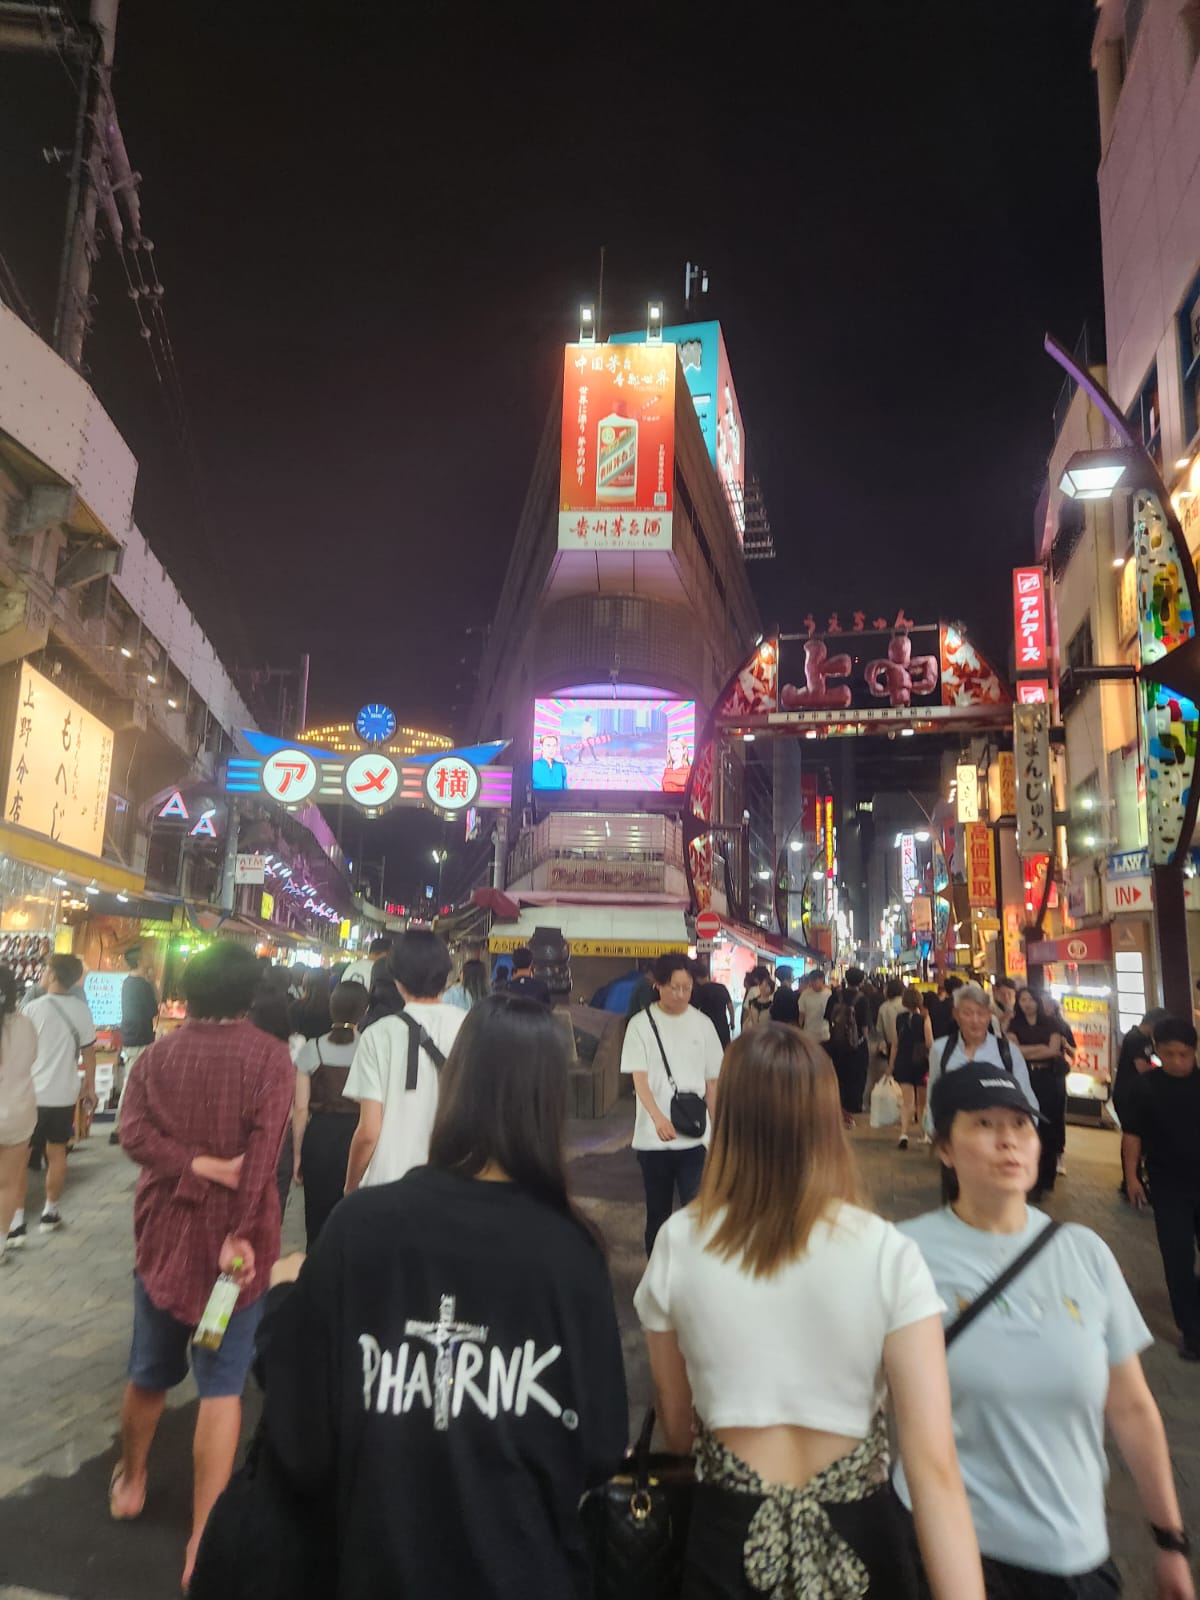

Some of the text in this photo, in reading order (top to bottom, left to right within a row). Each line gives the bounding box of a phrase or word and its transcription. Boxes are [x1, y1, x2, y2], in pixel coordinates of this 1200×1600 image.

[9, 679, 35, 824] 上野分店
[50, 709, 72, 842] もへじ
[273, 761, 469, 799] アメ横
[240, 857, 263, 866] ATM
[970, 823, 992, 897] 高価買取
[1115, 886, 1132, 906] IN
